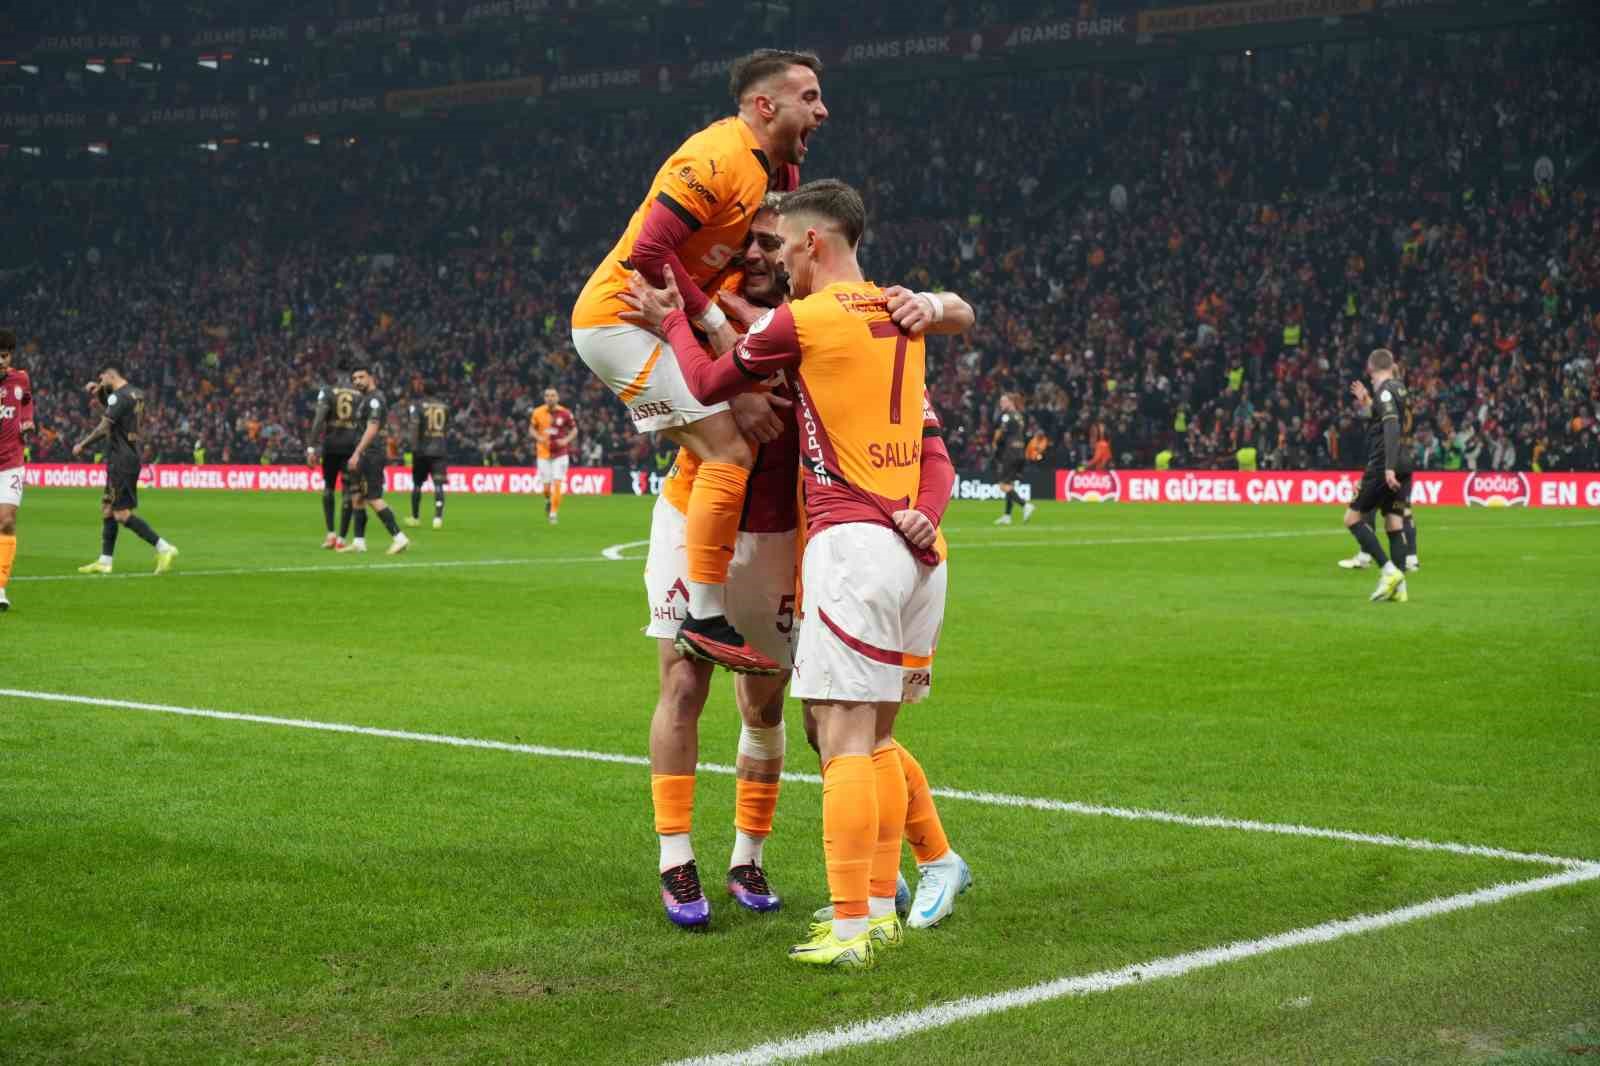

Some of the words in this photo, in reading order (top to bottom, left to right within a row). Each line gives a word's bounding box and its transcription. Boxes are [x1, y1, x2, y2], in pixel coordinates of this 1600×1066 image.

[1019, 22, 1071, 41] RAMS
[1076, 16, 1126, 35] PARK
[851, 40, 900, 59] RAMS
[904, 34, 951, 54] PARK
[867, 319, 909, 424] 7
[336, 393, 352, 418] 6
[632, 401, 673, 422] ASHA
[425, 407, 446, 431] 10
[160, 470, 179, 488] EN
[1129, 479, 1160, 502] EN
[1165, 473, 1242, 502] GÜZEL
[1301, 474, 1352, 504] DOĞ
[1410, 479, 1443, 504] AY
[1541, 481, 1577, 505] EN
